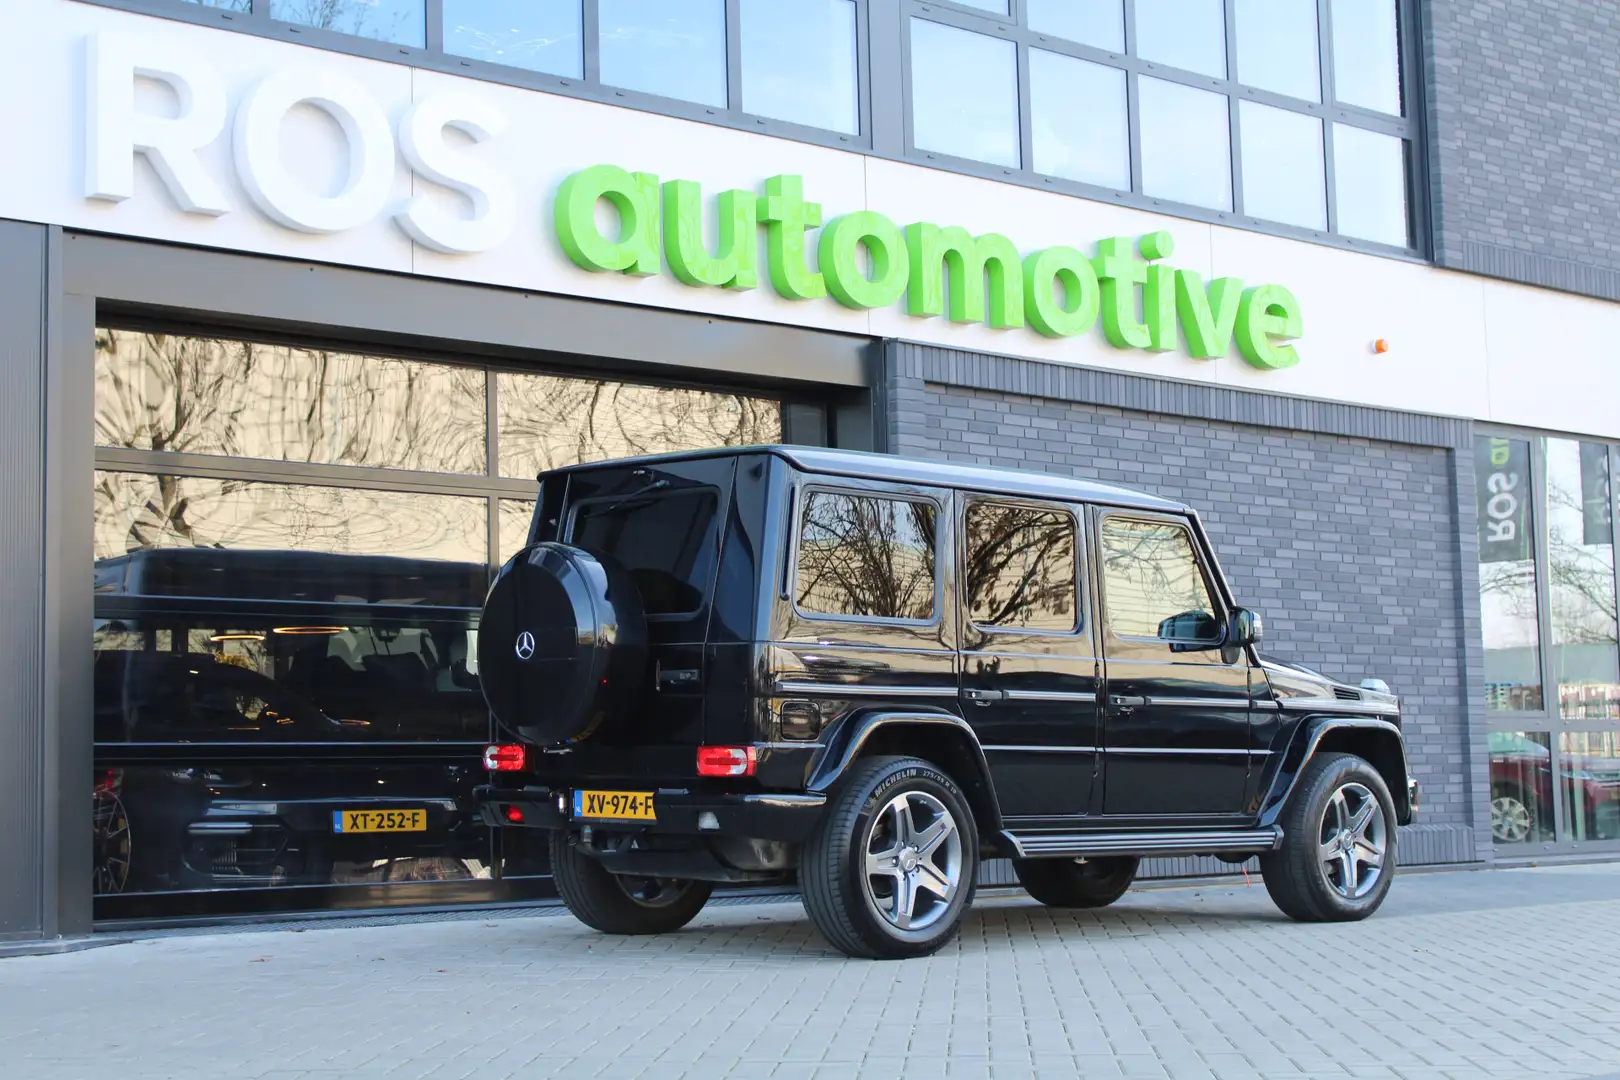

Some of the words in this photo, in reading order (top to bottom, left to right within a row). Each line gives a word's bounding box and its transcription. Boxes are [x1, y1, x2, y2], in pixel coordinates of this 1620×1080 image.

[85, 31, 515, 254] ROS
[554, 165, 1303, 370] automotive
[875, 769, 917, 797] MICHELIN
[587, 794, 653, 815] XV-974-F
[350, 812, 420, 829] XT-252-F
